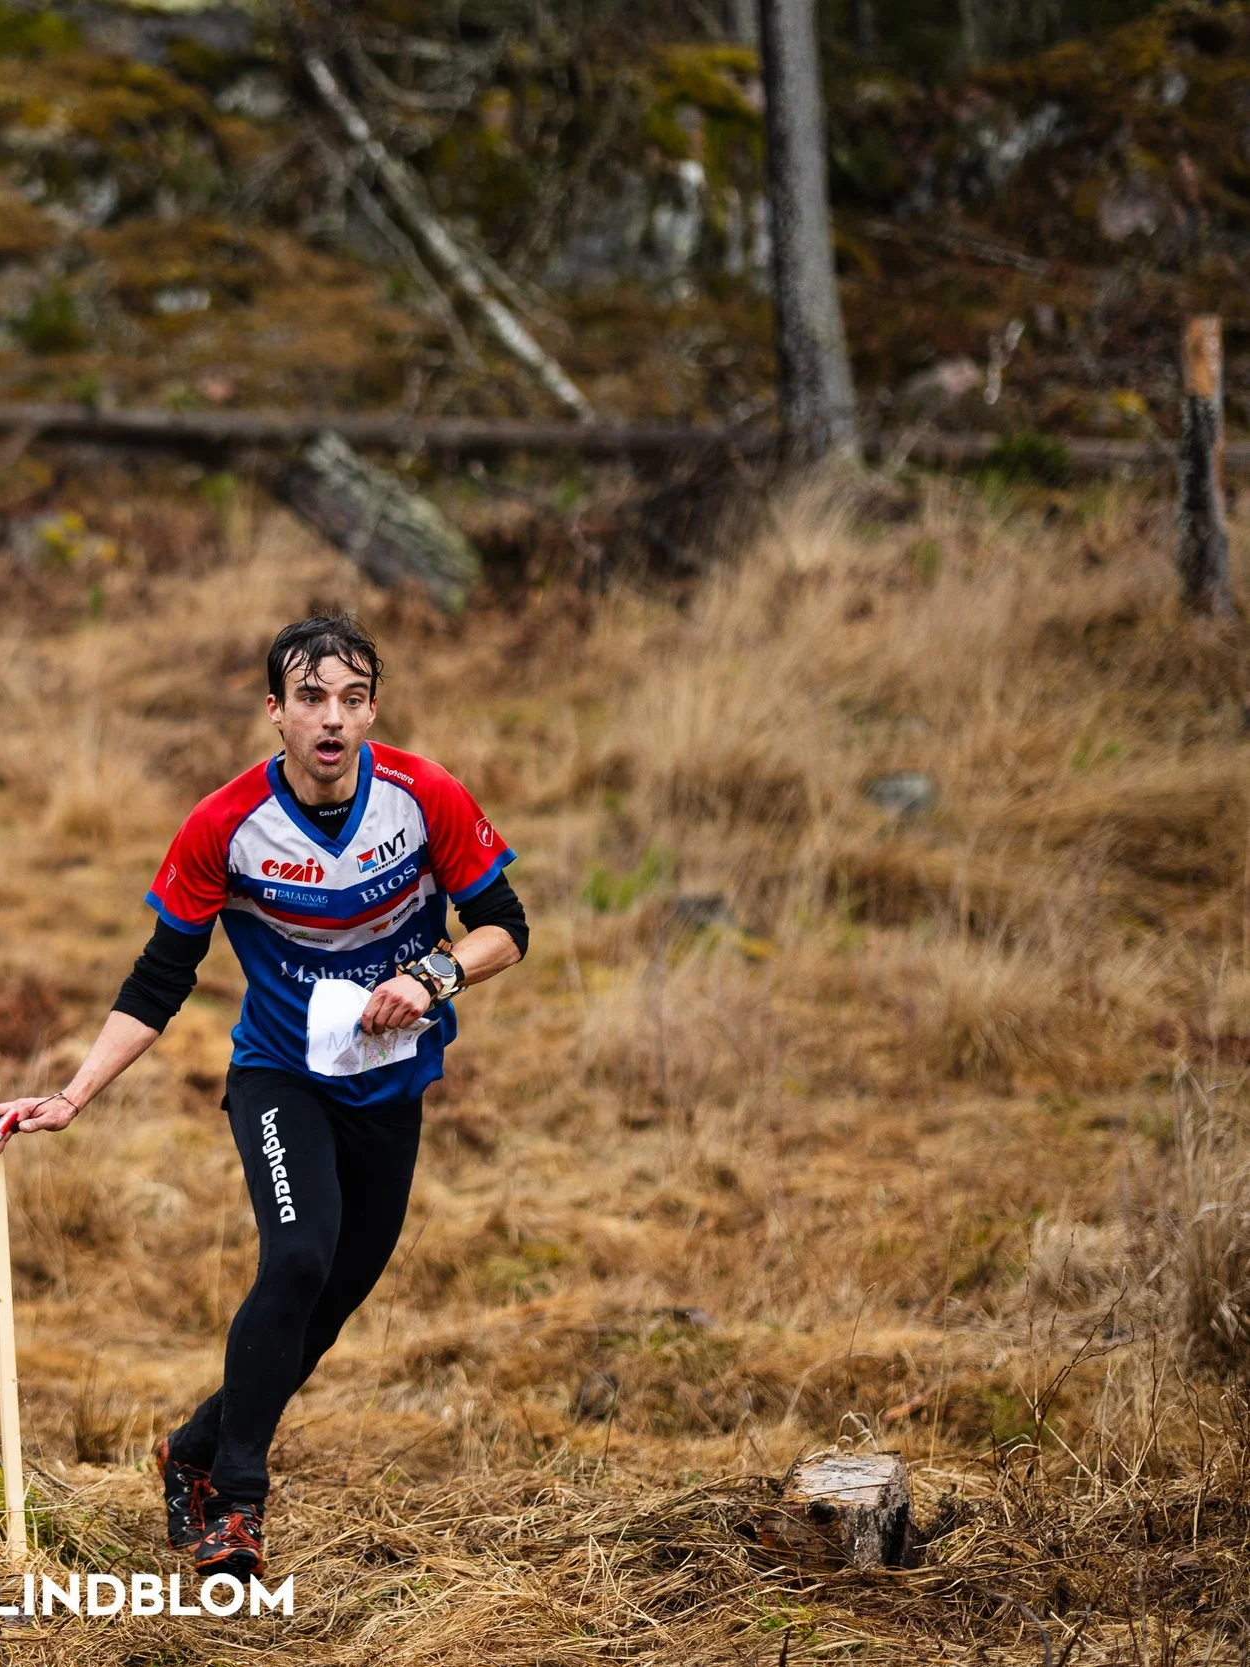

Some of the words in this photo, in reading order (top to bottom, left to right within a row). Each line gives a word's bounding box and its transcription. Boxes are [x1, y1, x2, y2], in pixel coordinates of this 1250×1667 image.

[319, 808, 343, 817] CRAFT
[378, 827, 406, 863] IVT
[261, 857, 325, 884] emit
[359, 863, 418, 905] BIOS
[280, 960, 388, 983] Malungs
[394, 933, 425, 964] OK
[261, 1107, 296, 1224] bagheera
